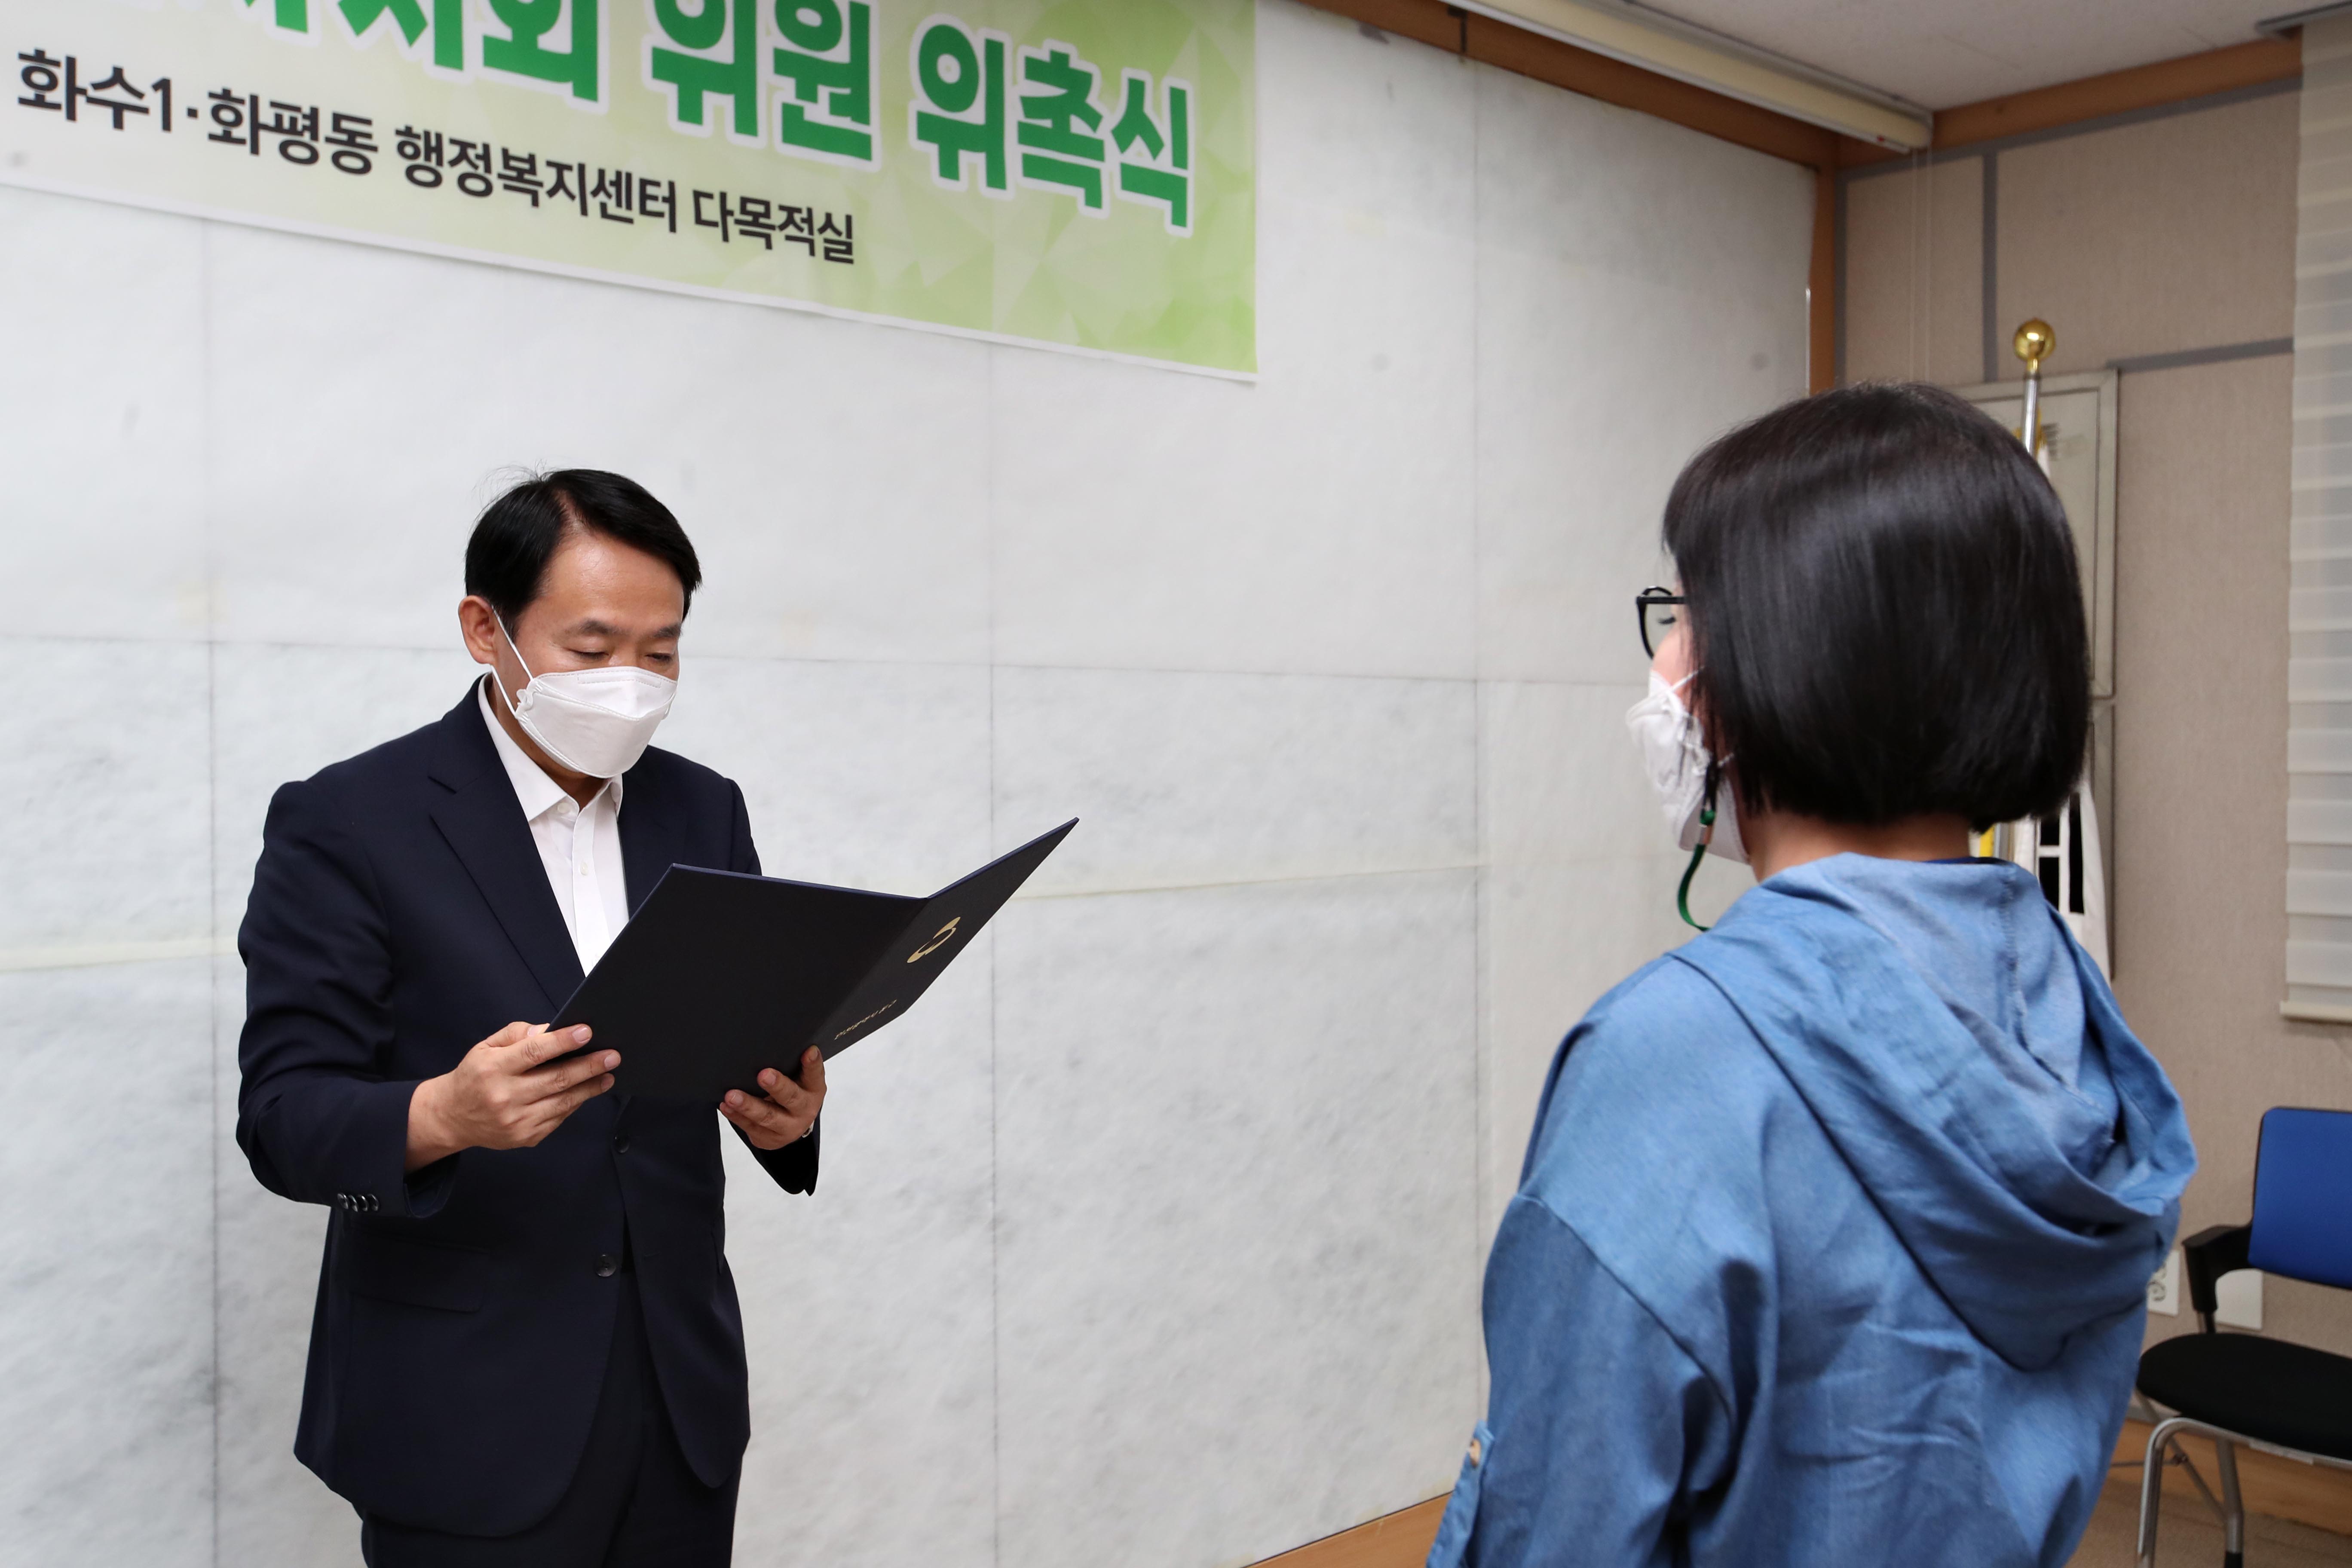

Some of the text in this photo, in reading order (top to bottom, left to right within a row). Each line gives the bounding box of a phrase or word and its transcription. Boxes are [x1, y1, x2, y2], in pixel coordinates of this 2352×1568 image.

[17, 48, 379, 177] 화수1·화평동
[394, 125, 677, 234] 행정복지센터
[692, 189, 855, 265] 다목적실
[652, 0, 872, 161] 위원
[916, 24, 1189, 229] 위촉식
